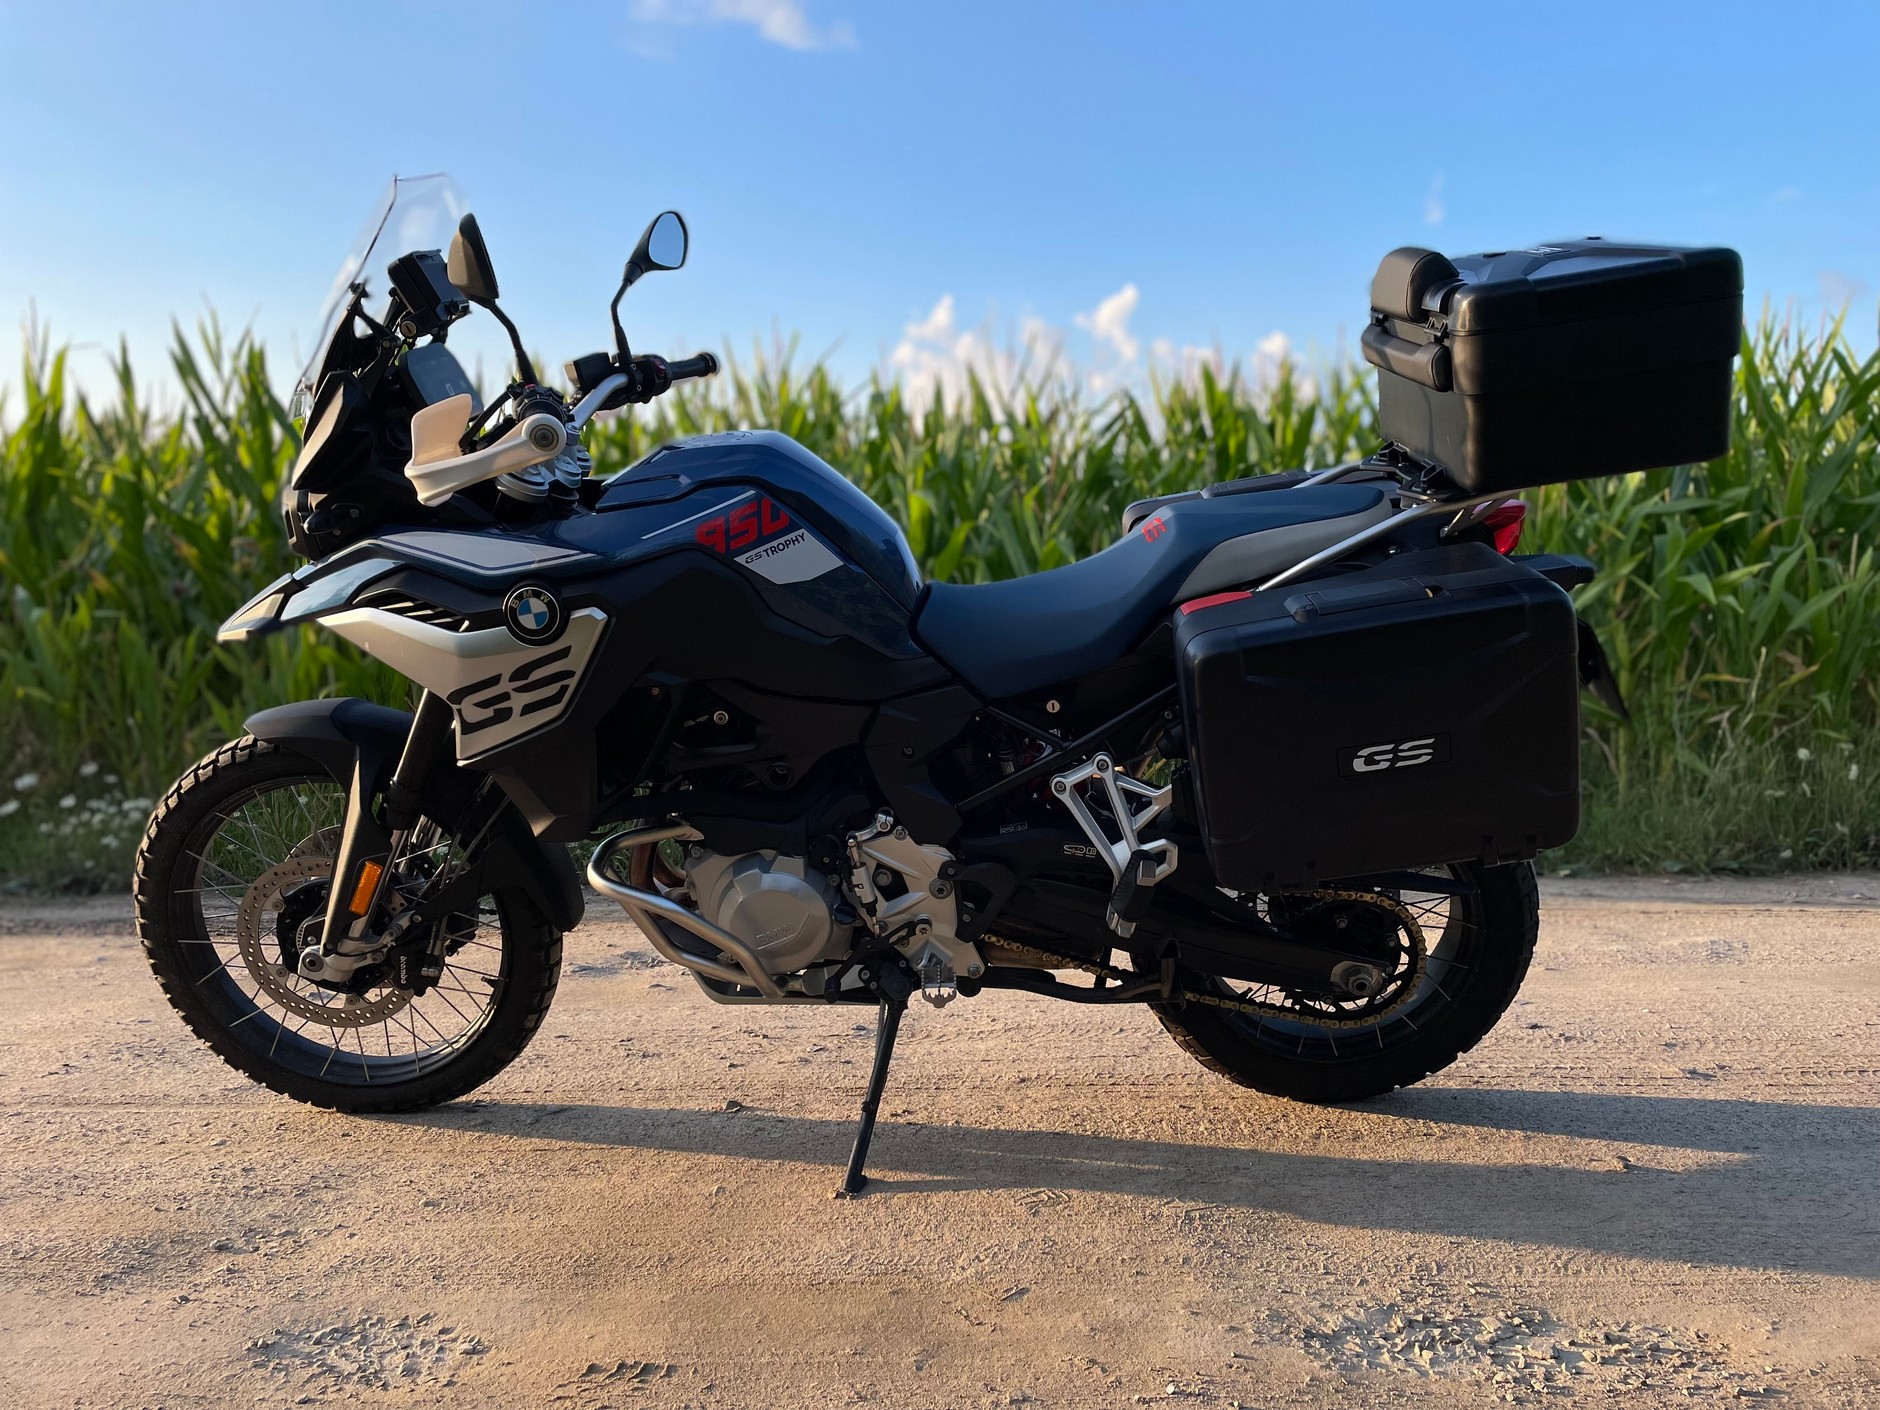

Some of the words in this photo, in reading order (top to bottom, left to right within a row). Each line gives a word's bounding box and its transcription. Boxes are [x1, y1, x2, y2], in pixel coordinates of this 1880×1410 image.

[510, 590, 550, 608] BMW
[446, 645, 576, 735] GS
[1352, 738, 1435, 772] GS
[756, 923, 793, 946] BMW
[400, 955, 408, 984] brembo
